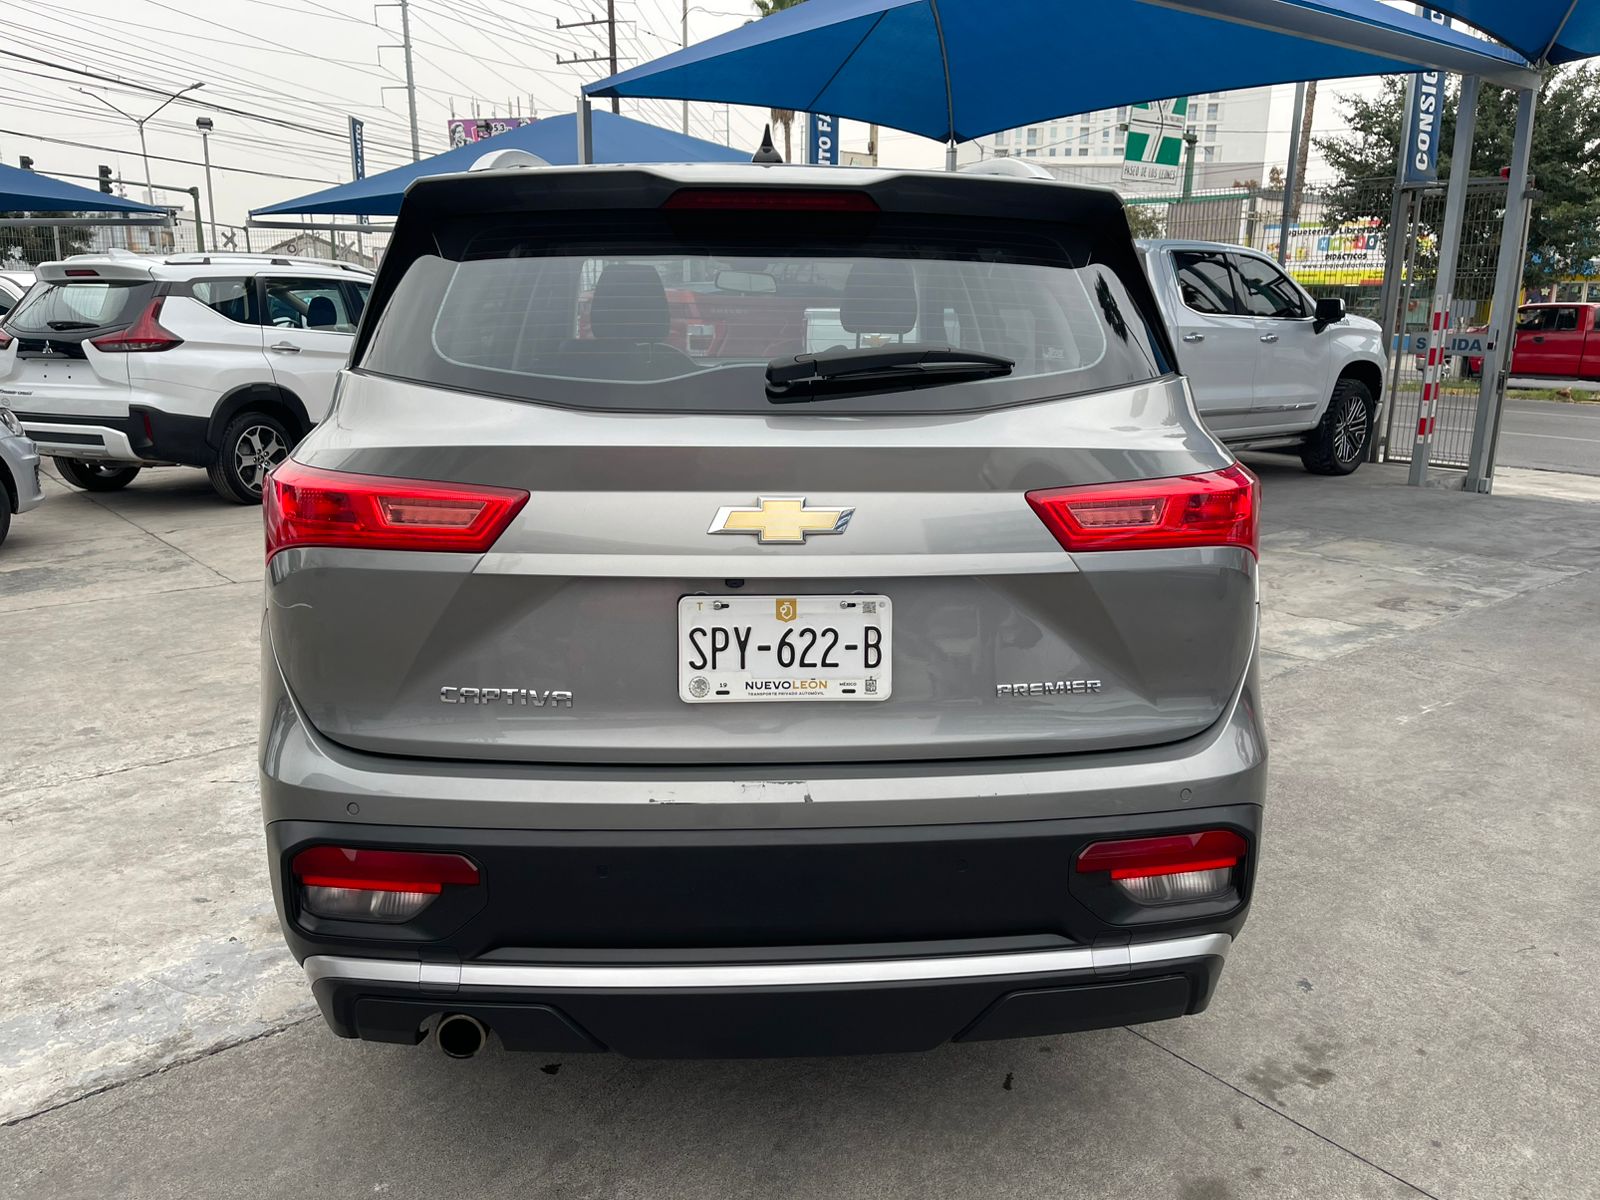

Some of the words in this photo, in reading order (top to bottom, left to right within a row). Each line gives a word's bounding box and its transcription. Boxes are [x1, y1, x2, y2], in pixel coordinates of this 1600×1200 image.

[688, 626, 883, 671] SPY-622-B
[440, 686, 573, 708] CAPTIVA
[996, 680, 1102, 698] PREMIER
